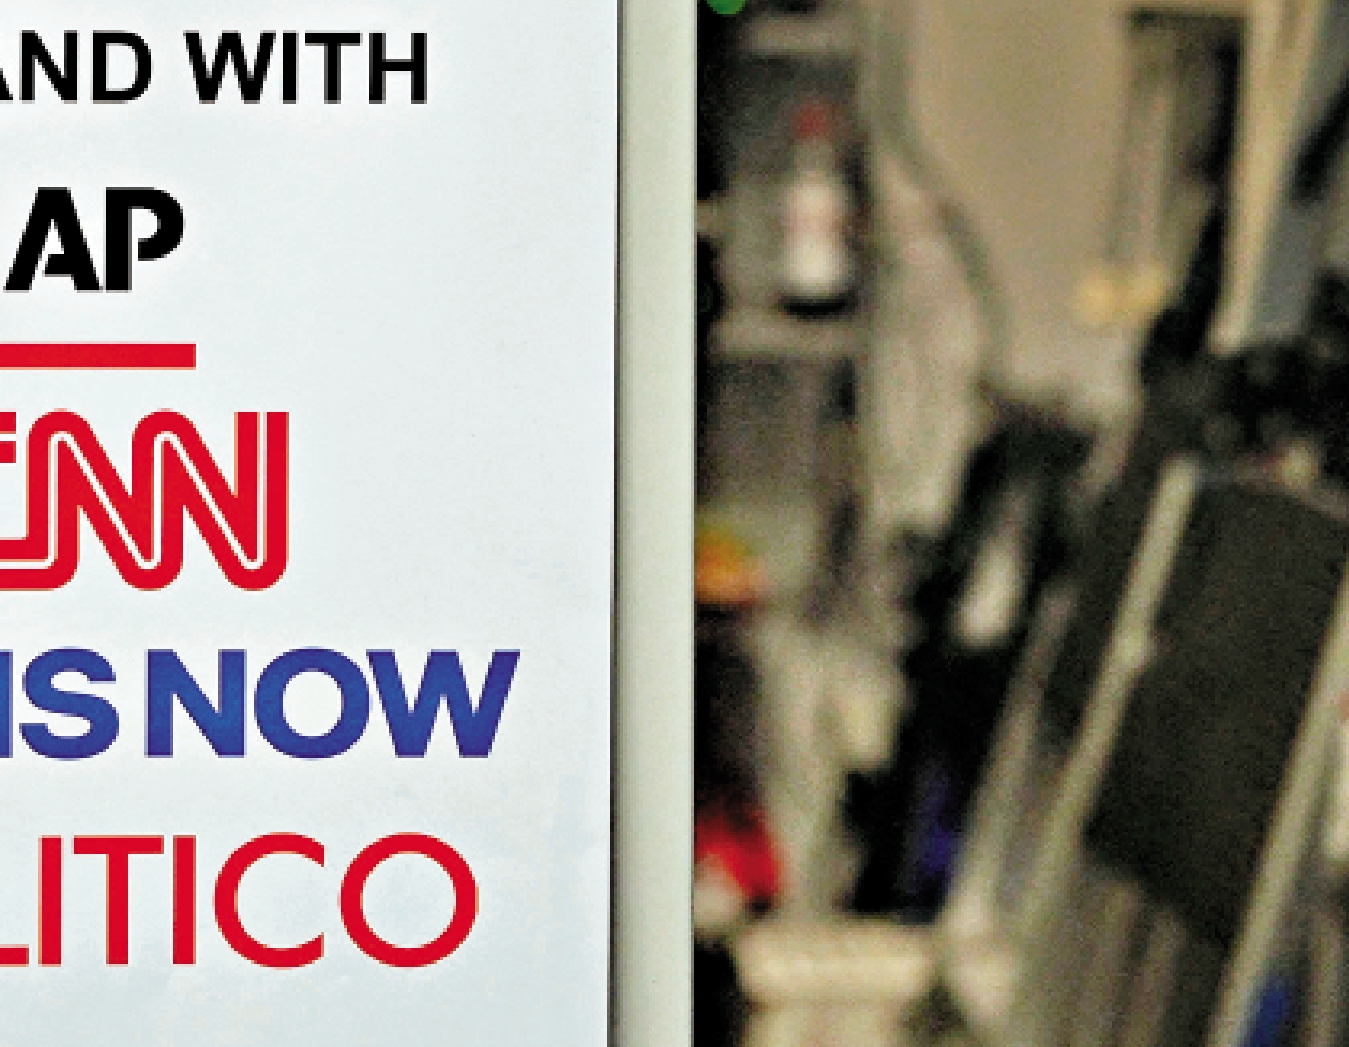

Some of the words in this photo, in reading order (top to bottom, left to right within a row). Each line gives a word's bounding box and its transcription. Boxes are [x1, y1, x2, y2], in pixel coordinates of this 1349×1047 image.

[185, 31, 428, 105] WITH
[4, 186, 184, 291] AP
[146, 648, 521, 759] NOW
